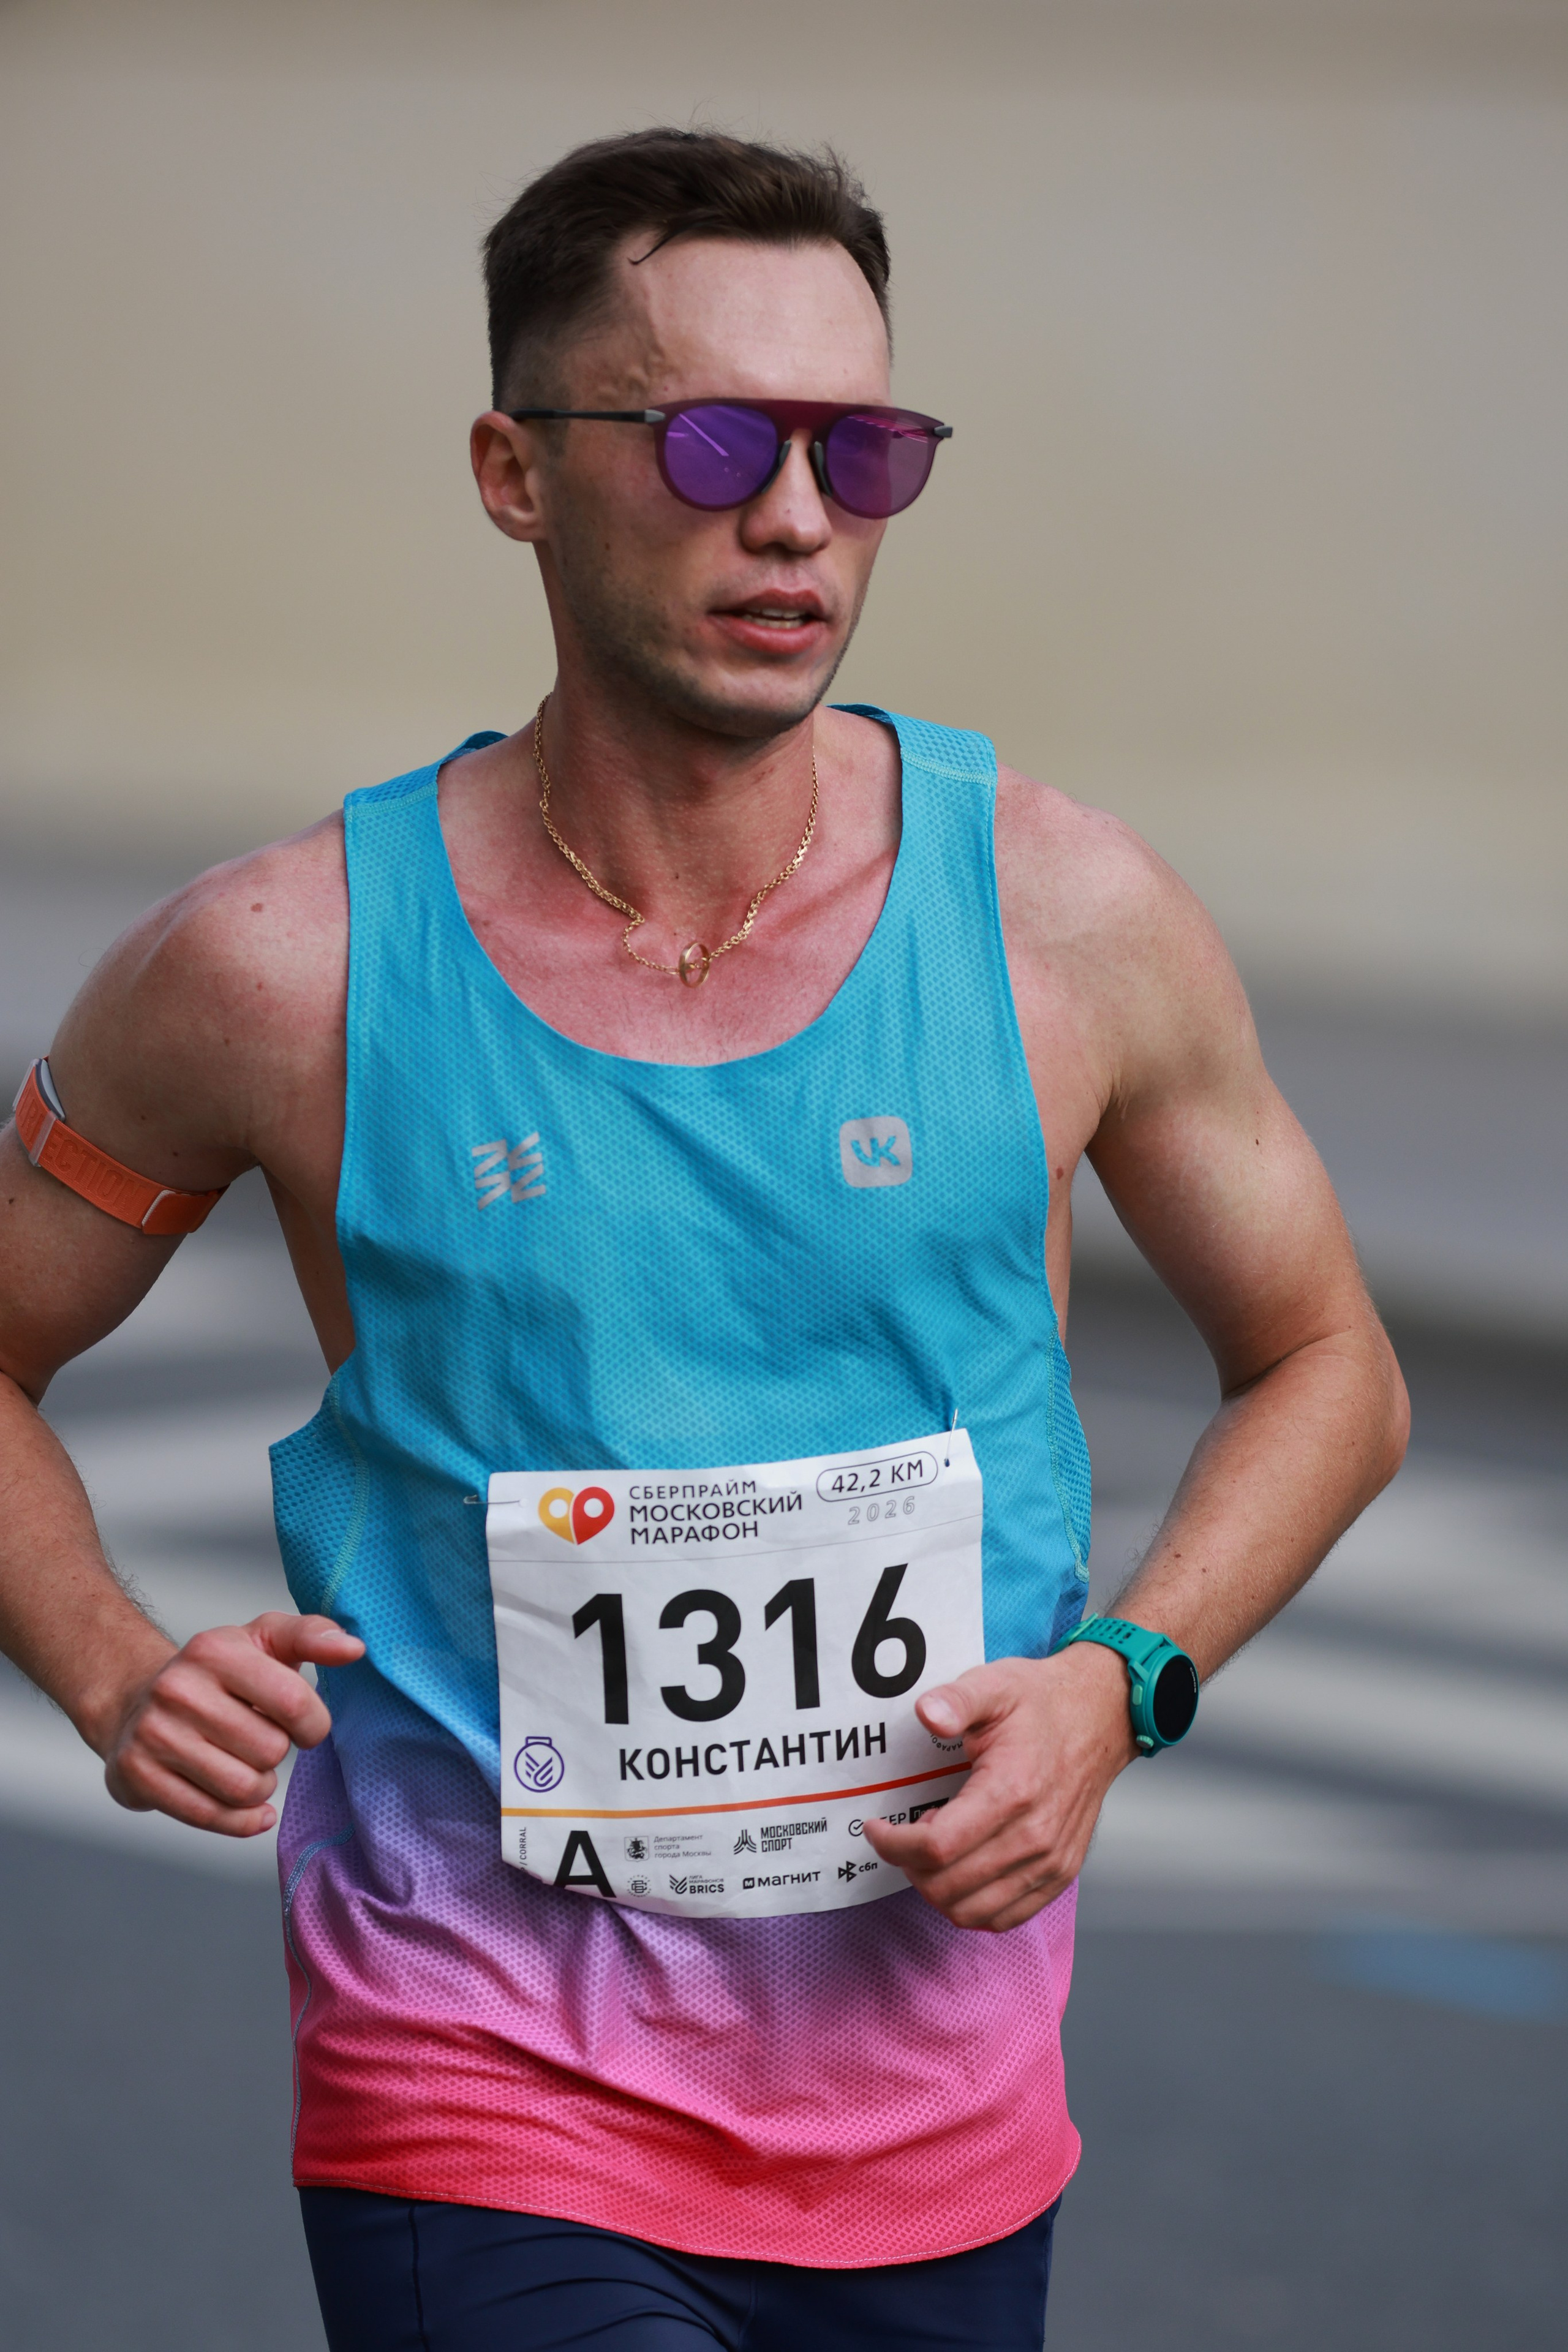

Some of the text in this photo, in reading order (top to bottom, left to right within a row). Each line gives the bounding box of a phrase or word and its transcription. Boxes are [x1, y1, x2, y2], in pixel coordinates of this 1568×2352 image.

[850, 1136, 901, 1167] VK
[629, 1479, 756, 1500] СБЕРПРАЙМ
[831, 1459, 923, 1493] 42,2 КМ
[630, 1490, 802, 1523] МОСКОВСКИЙ
[847, 1496, 915, 1526] 2026
[631, 1521, 758, 1545] МАРАФОН
[571, 1563, 927, 1725] 1316
[619, 1722, 886, 1781] КОНСТАНТИН
[760, 1817, 827, 1840] МОСКОВСКИЙ
[761, 1838, 793, 1853] СПОРТ
[859, 1862, 878, 1872] сбп
[690, 1883, 725, 1894] BRICS
